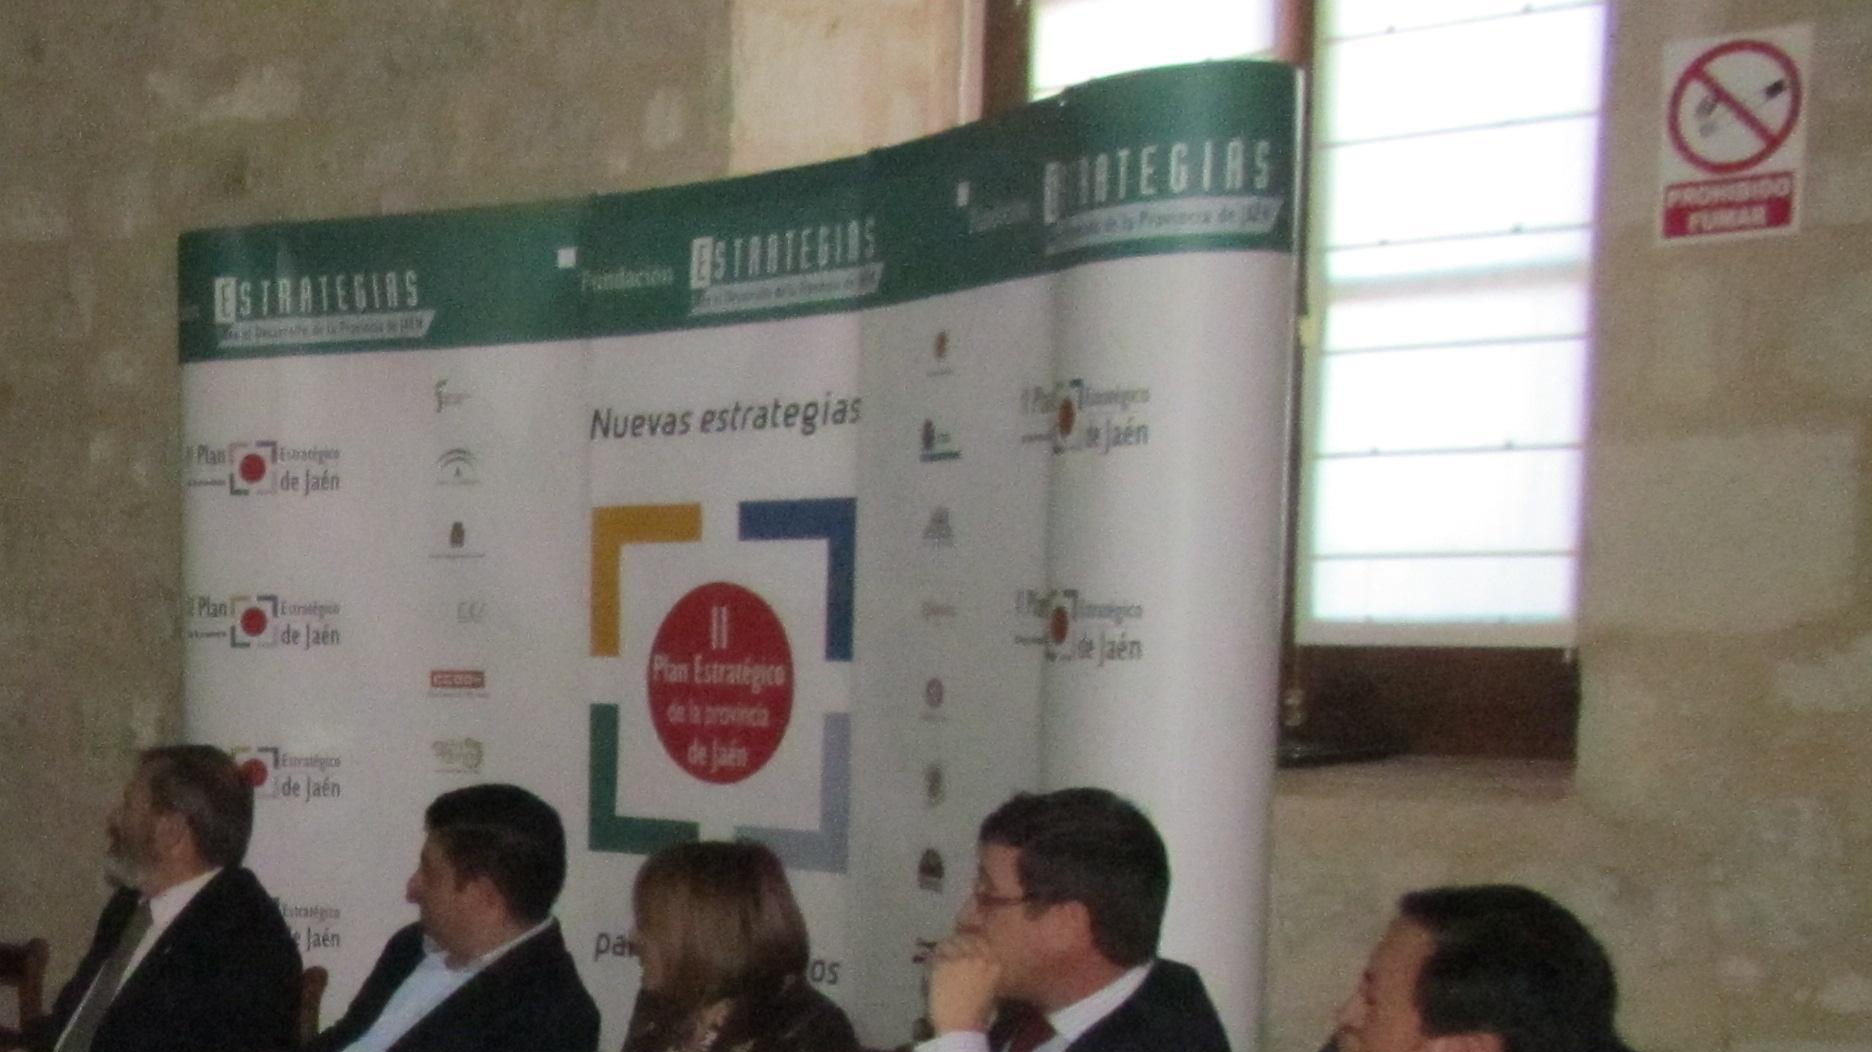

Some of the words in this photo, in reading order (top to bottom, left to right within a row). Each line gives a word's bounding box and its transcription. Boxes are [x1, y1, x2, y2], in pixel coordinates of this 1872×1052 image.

[1688, 205, 1766, 234] FUMAR
[215, 269, 419, 324] ESTRATEGIAS
[589, 407, 693, 440] Nuevas
[699, 391, 863, 436] estrategias
[197, 444, 226, 465] Plan
[280, 470, 300, 491] de
[303, 468, 340, 496] Jaén
[197, 595, 227, 618] Plan
[280, 623, 301, 645] de
[304, 622, 340, 650] Jaén
[711, 605, 728, 651] II
[653, 653, 689, 684] Plan
[693, 653, 786, 695] Estratégico
[666, 701, 686, 725] de
[688, 700, 702, 725] la
[704, 703, 770, 729] provincia
[687, 738, 708, 766] de
[711, 739, 749, 774] Jaén
[281, 777, 301, 797] de
[305, 775, 341, 803] Jaén
[306, 926, 341, 953] Jaén
